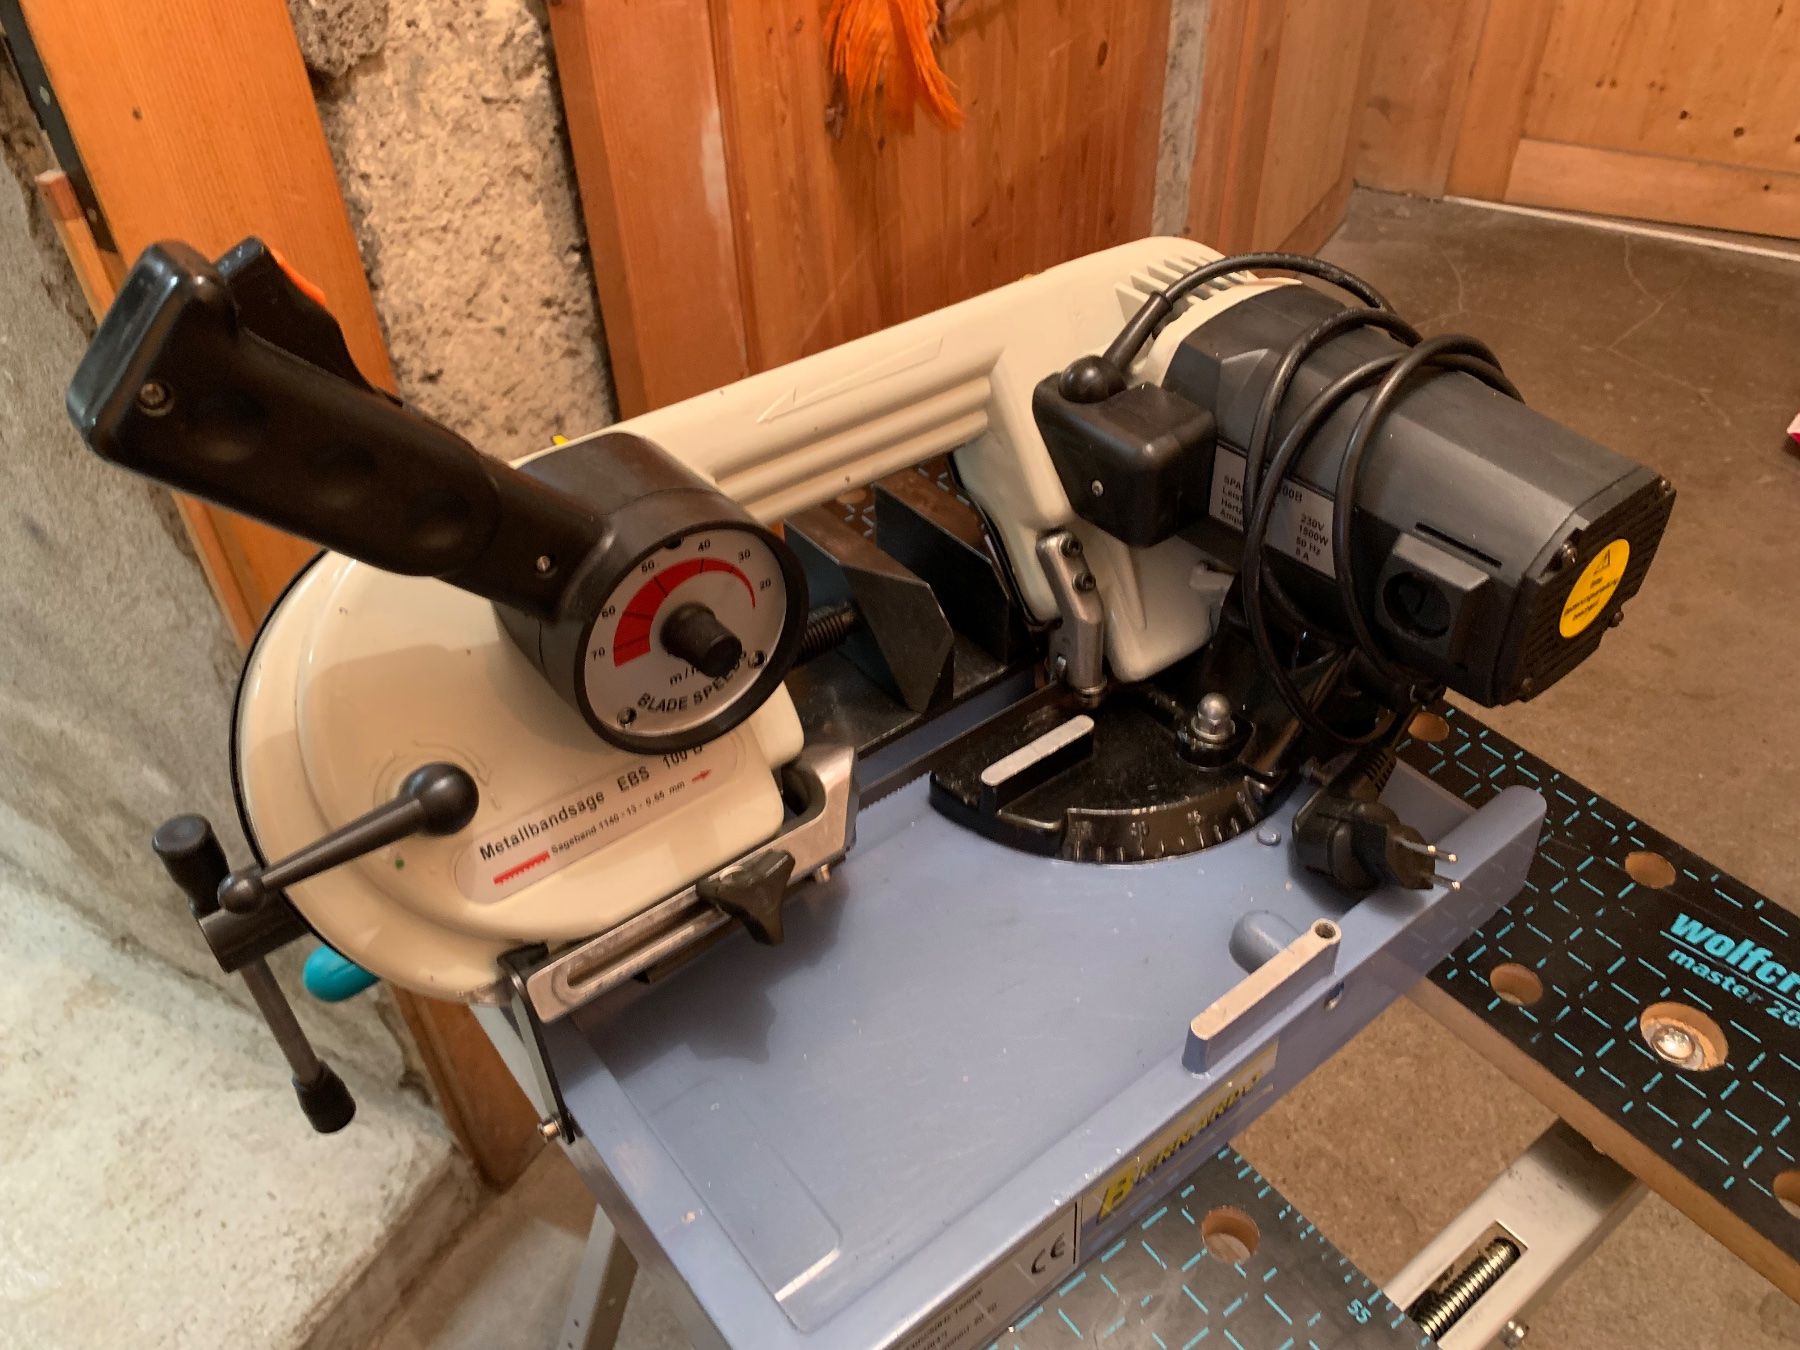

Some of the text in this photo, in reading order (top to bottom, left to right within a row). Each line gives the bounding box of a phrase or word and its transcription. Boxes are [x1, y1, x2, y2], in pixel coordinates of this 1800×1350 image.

[1301, 514, 1325, 530] 230V
[697, 539, 711, 552] 40
[738, 549, 751, 563] 30
[641, 559, 655, 573] 50
[759, 578, 772, 591] 20
[601, 605, 616, 619] 60
[591, 646, 606, 661] 70
[637, 692, 689, 712] BLADE
[617, 766, 650, 792] EBS
[669, 781, 685, 796] mm
[1670, 912, 1800, 1002] wolfcr
[1765, 1000, 1800, 1028] 20
[1030, 1232, 1066, 1275] CE
[1346, 1298, 1372, 1324] 55
